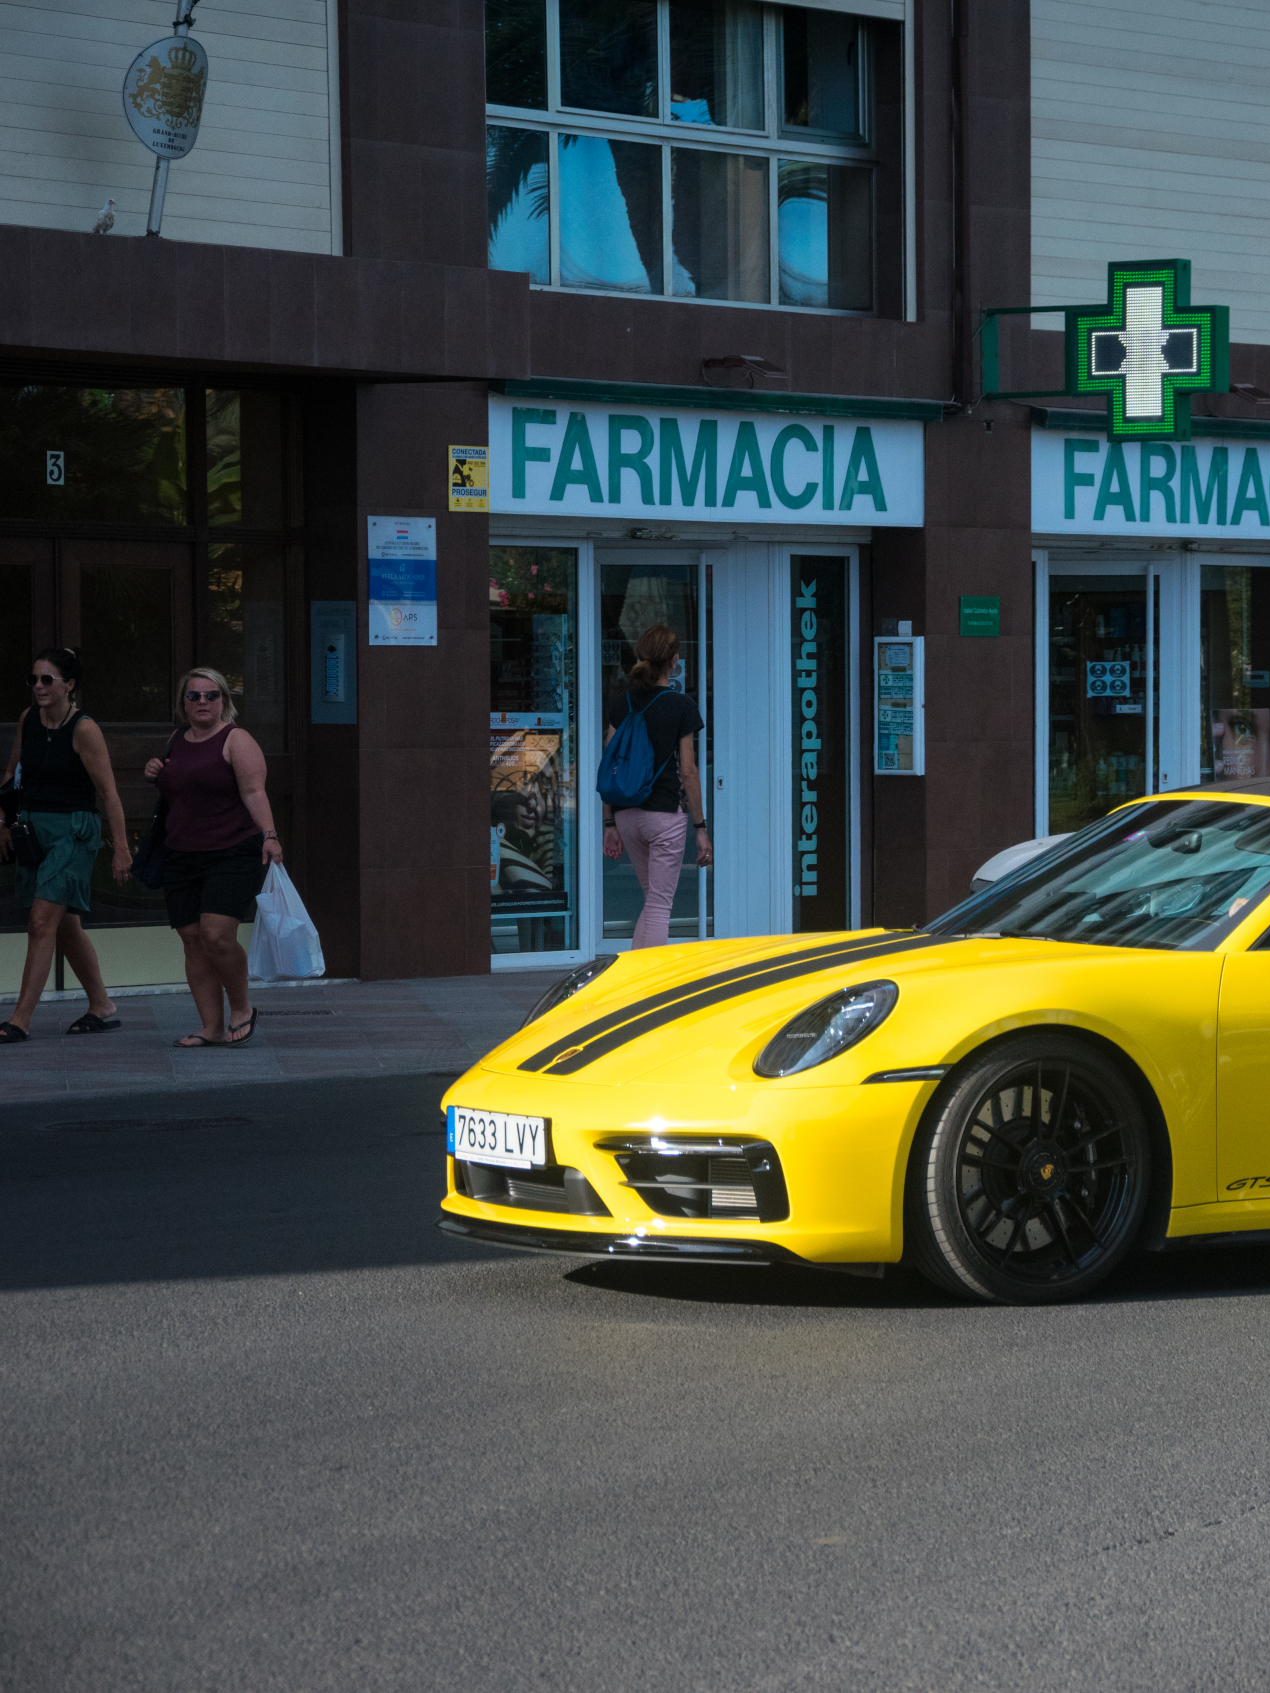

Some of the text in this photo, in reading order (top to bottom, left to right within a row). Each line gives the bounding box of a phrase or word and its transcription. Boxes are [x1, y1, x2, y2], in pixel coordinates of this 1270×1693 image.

[452, 448, 487, 456] CONECTADA
[511, 407, 887, 511] FARMACIA
[49, 453, 62, 482] 3
[452, 489, 487, 497] PROSEGUR
[403, 613, 418, 621] APS
[794, 578, 821, 896] interapothek
[458, 1114, 539, 1156] 7633 LVY
